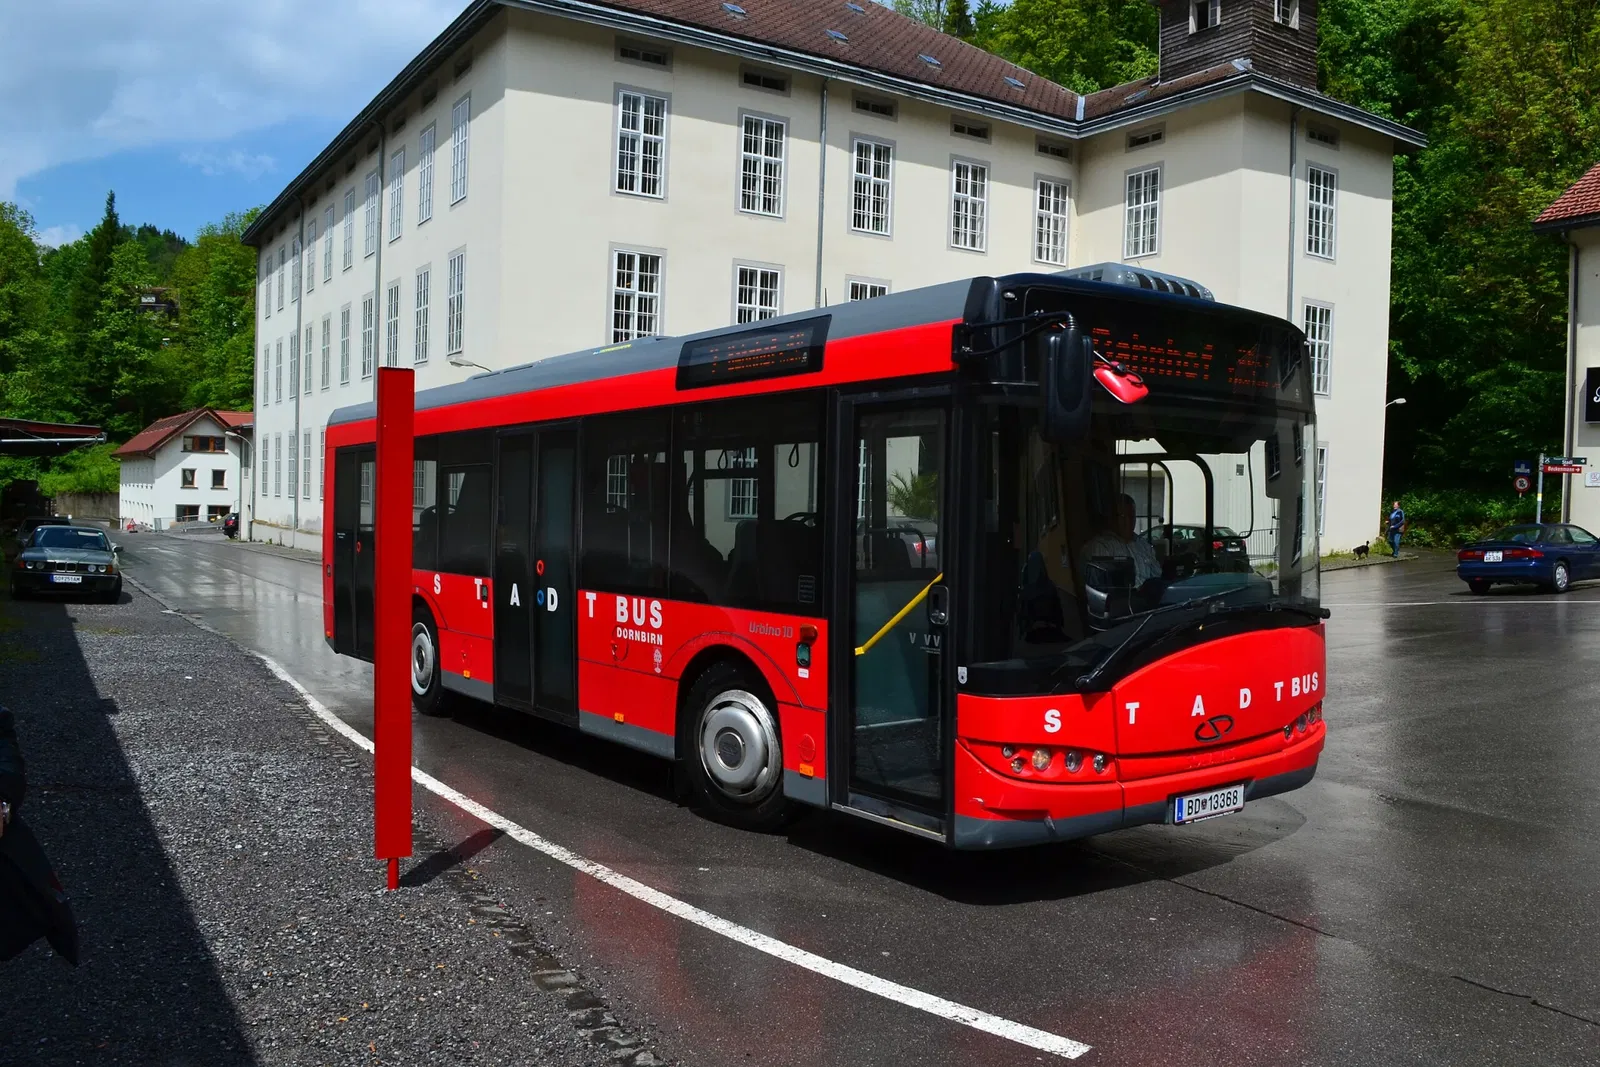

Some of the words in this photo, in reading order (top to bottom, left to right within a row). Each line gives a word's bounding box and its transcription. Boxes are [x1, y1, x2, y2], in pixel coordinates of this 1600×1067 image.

[433, 573, 441, 595] S
[474, 578, 483, 600] T
[510, 583, 520, 607] A
[547, 587, 559, 612] D
[585, 592, 597, 618] T
[616, 595, 663, 629] BUS
[616, 626, 663, 645] DORNBIRN
[748, 621, 781, 637] Urbino
[782, 625, 793, 638] 10
[1043, 708, 1062, 733] S
[1125, 702, 1140, 724] T
[1191, 694, 1205, 717] A
[1239, 688, 1252, 709] D
[1274, 681, 1284, 701] T
[1291, 671, 1319, 698] BUS
[1187, 798, 1200, 816] BD
[1208, 789, 1238, 811] 13368
